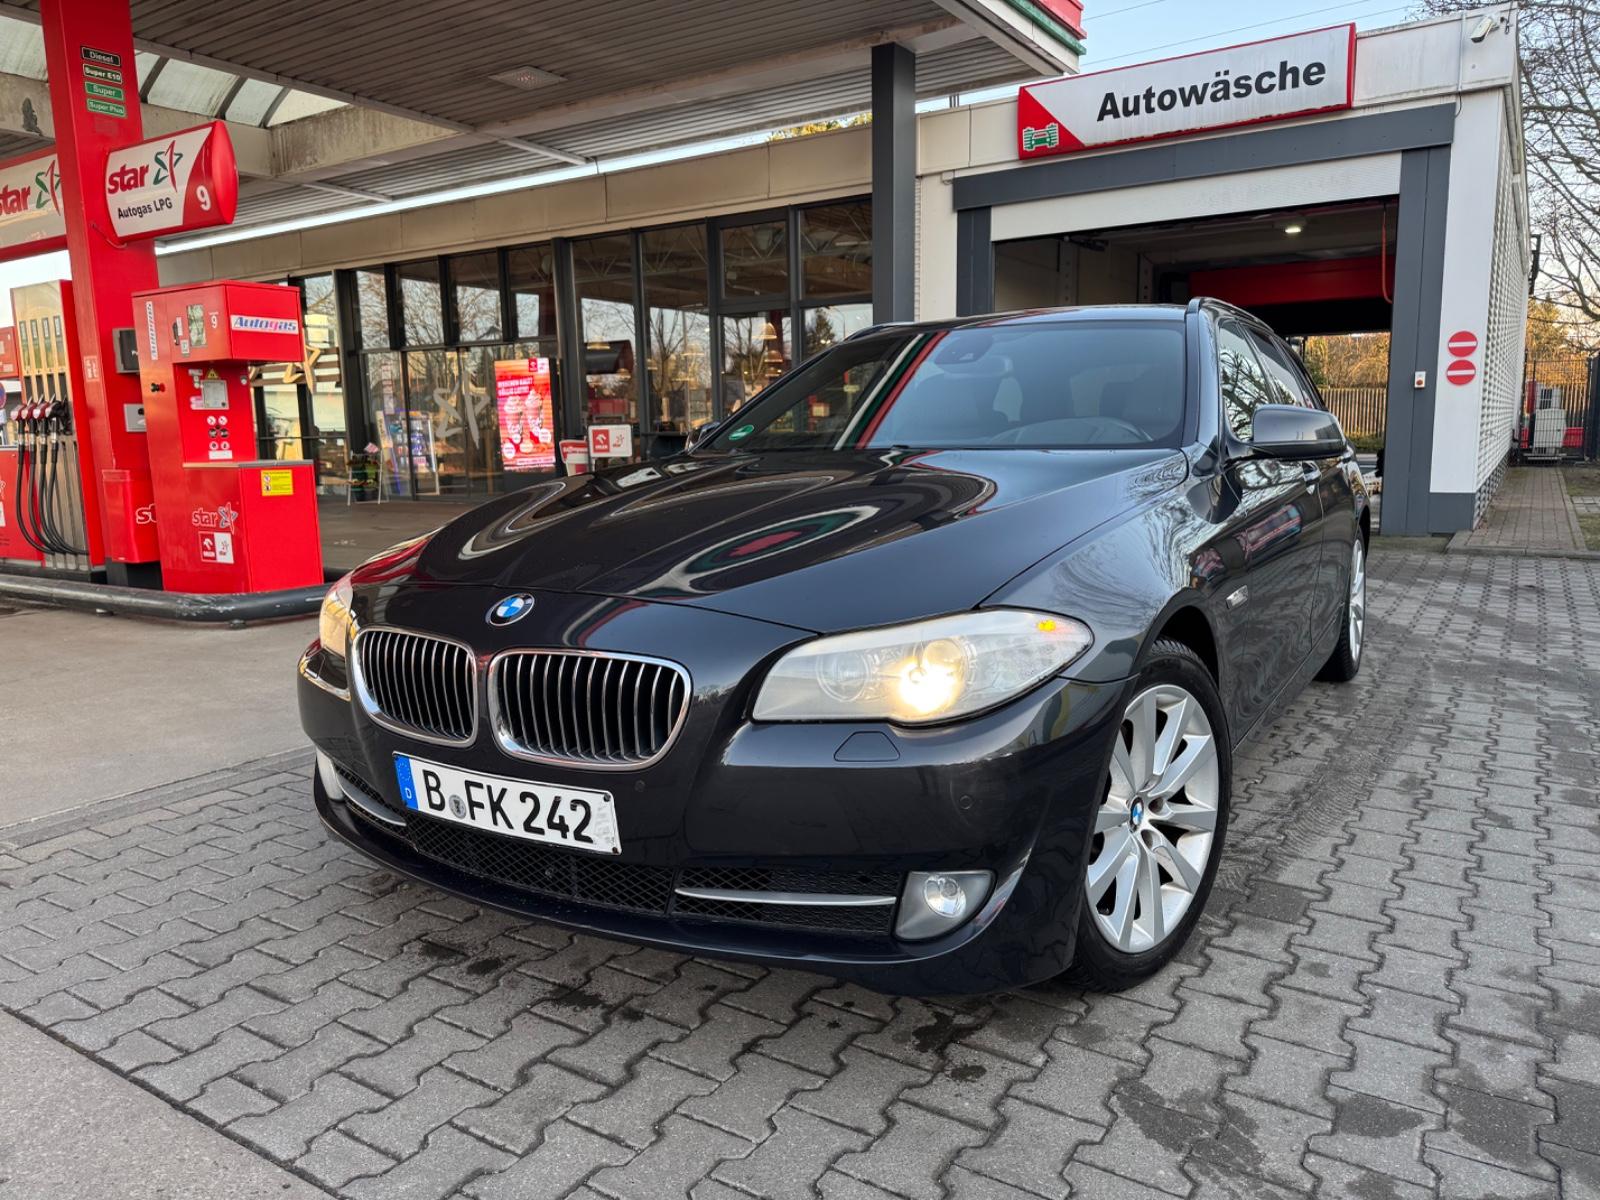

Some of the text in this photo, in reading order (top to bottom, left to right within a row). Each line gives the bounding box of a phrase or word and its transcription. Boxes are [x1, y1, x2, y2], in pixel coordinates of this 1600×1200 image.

[89, 51, 114, 63] Diesel
[84, 66, 106, 77] Super
[92, 84, 116, 96] Super
[1097, 60, 1326, 121] Autowäsche
[89, 101, 109, 111] Super
[108, 164, 149, 195] star
[0, 184, 31, 215] tar
[196, 186, 211, 211] 9
[118, 197, 173, 219] Autogas LPG
[210, 315, 218, 329] 9
[234, 316, 297, 331] Autogas
[192, 507, 219, 528] star
[406, 788, 413, 799] D
[423, 769, 594, 844] B FK 242
